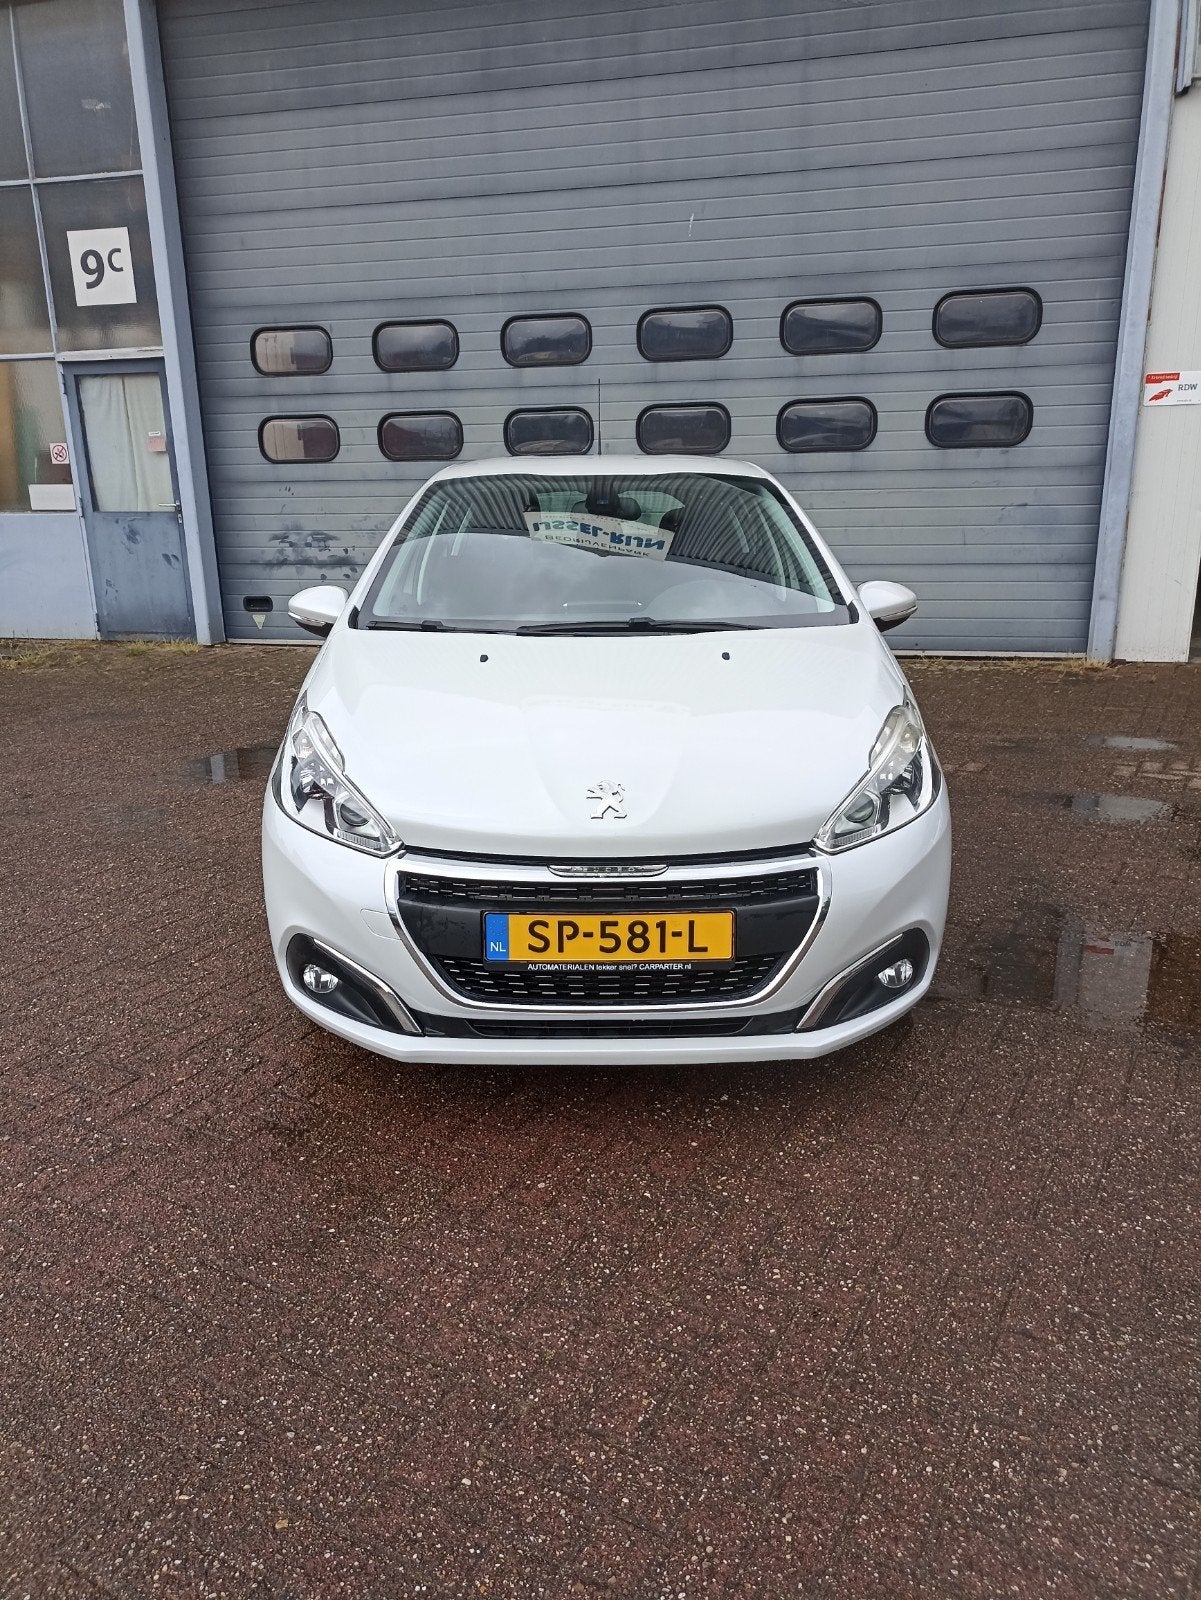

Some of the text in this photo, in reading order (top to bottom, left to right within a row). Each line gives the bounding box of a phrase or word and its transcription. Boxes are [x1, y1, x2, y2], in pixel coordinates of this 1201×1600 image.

[1178, 383, 1198, 391] RDW
[527, 919, 709, 954] SP-581-L
[490, 941, 506, 952] NL
[527, 963, 595, 971] AUTOMATERIALEN
